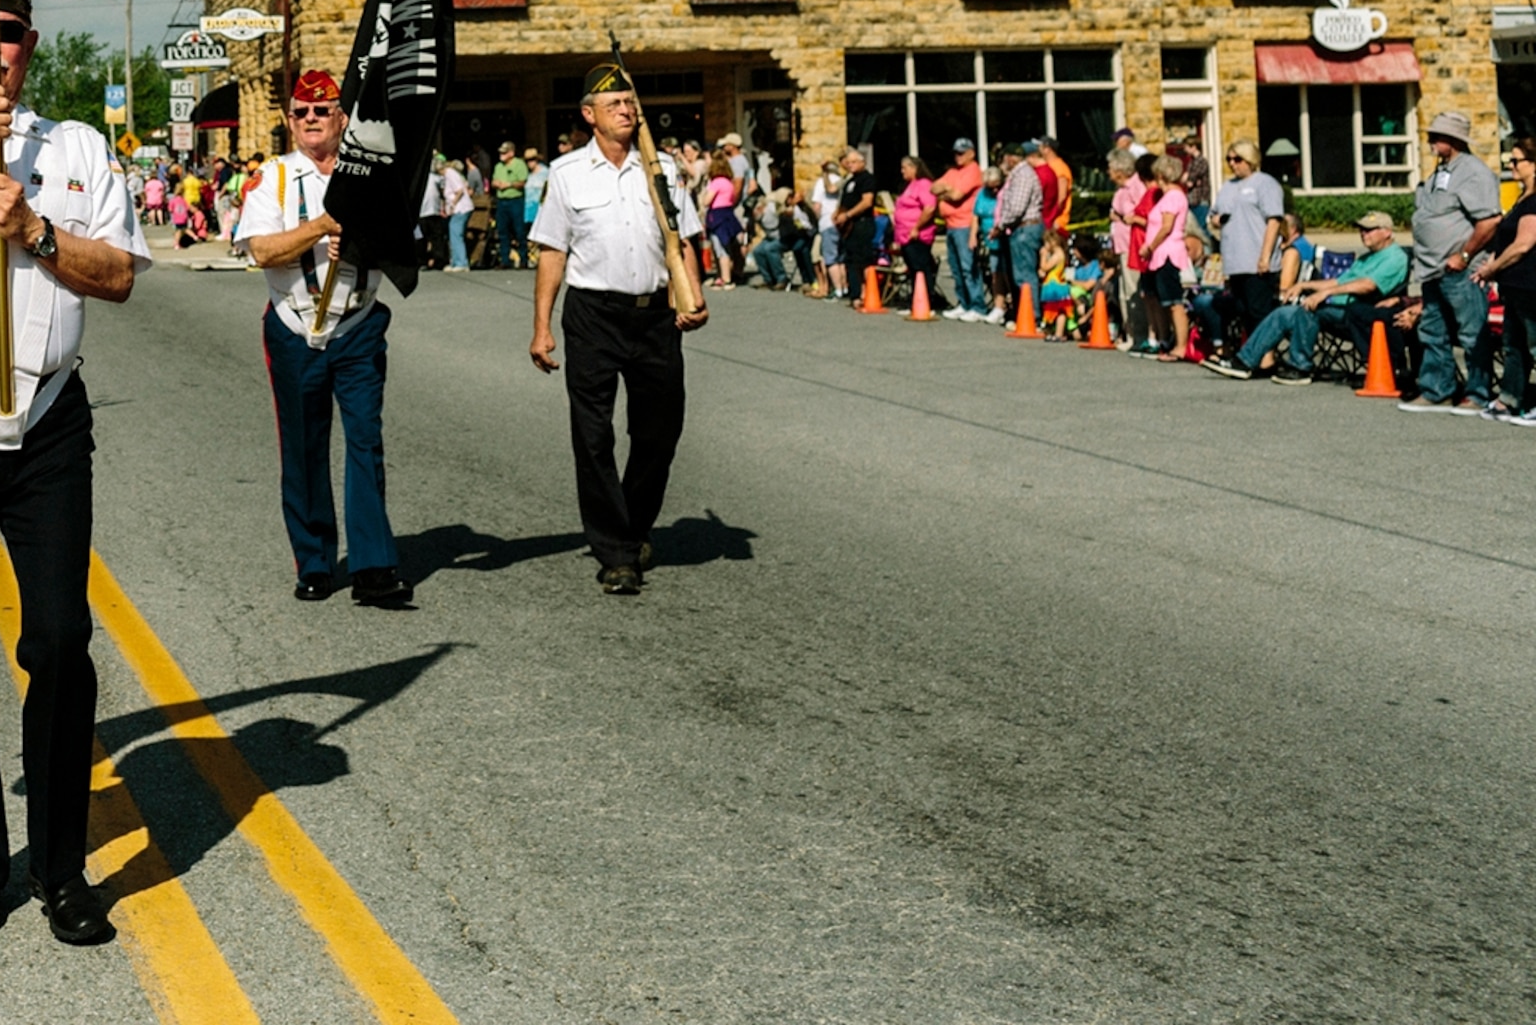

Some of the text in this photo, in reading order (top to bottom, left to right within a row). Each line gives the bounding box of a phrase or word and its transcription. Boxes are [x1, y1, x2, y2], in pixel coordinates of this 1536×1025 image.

[1320, 25, 1365, 34] COFFEE
[1324, 34, 1363, 43] HOUSE
[167, 45, 224, 60] PORTICO
[174, 82, 193, 94] JCT
[174, 102, 190, 117] 87
